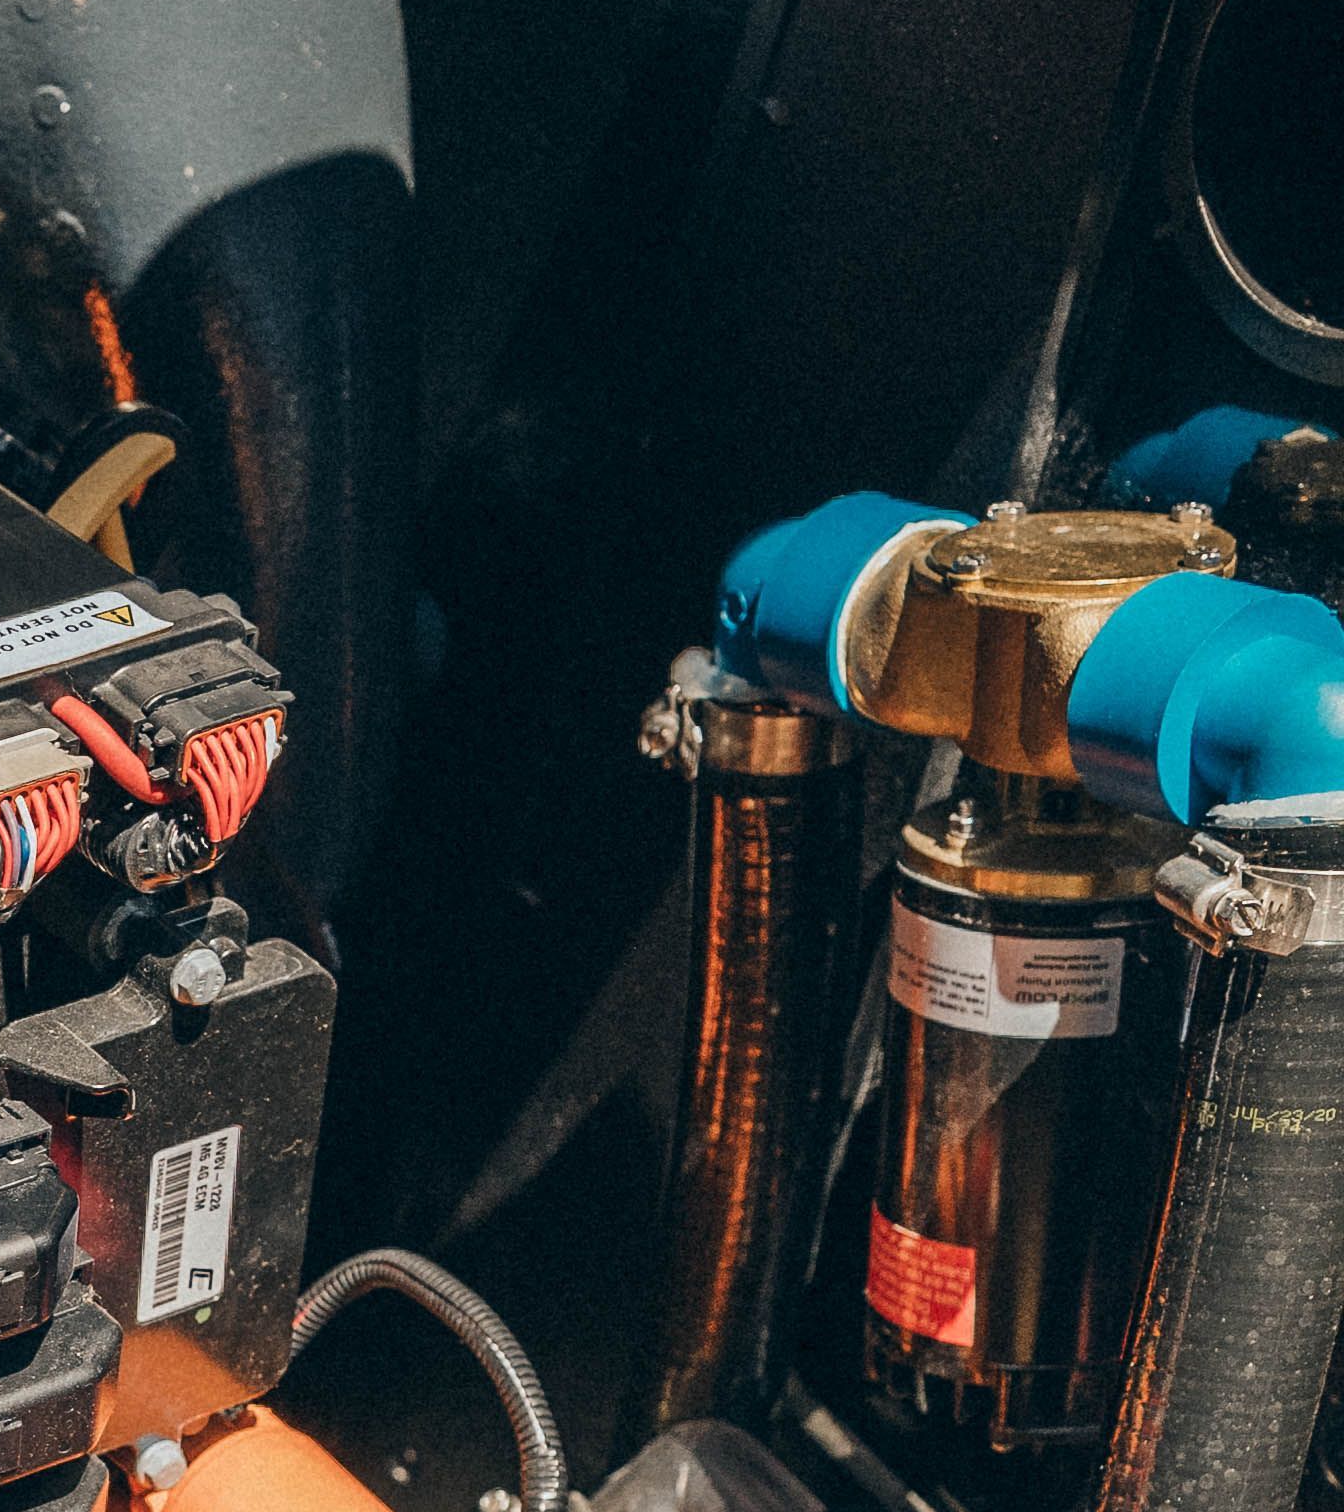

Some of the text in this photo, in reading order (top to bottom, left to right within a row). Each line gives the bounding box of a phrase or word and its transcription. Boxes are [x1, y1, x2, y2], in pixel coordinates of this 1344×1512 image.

[62, 601, 100, 619] NOT
[65, 620, 95, 634] DO
[23, 629, 61, 647] NOT
[193, 1184, 207, 1212] ECM
